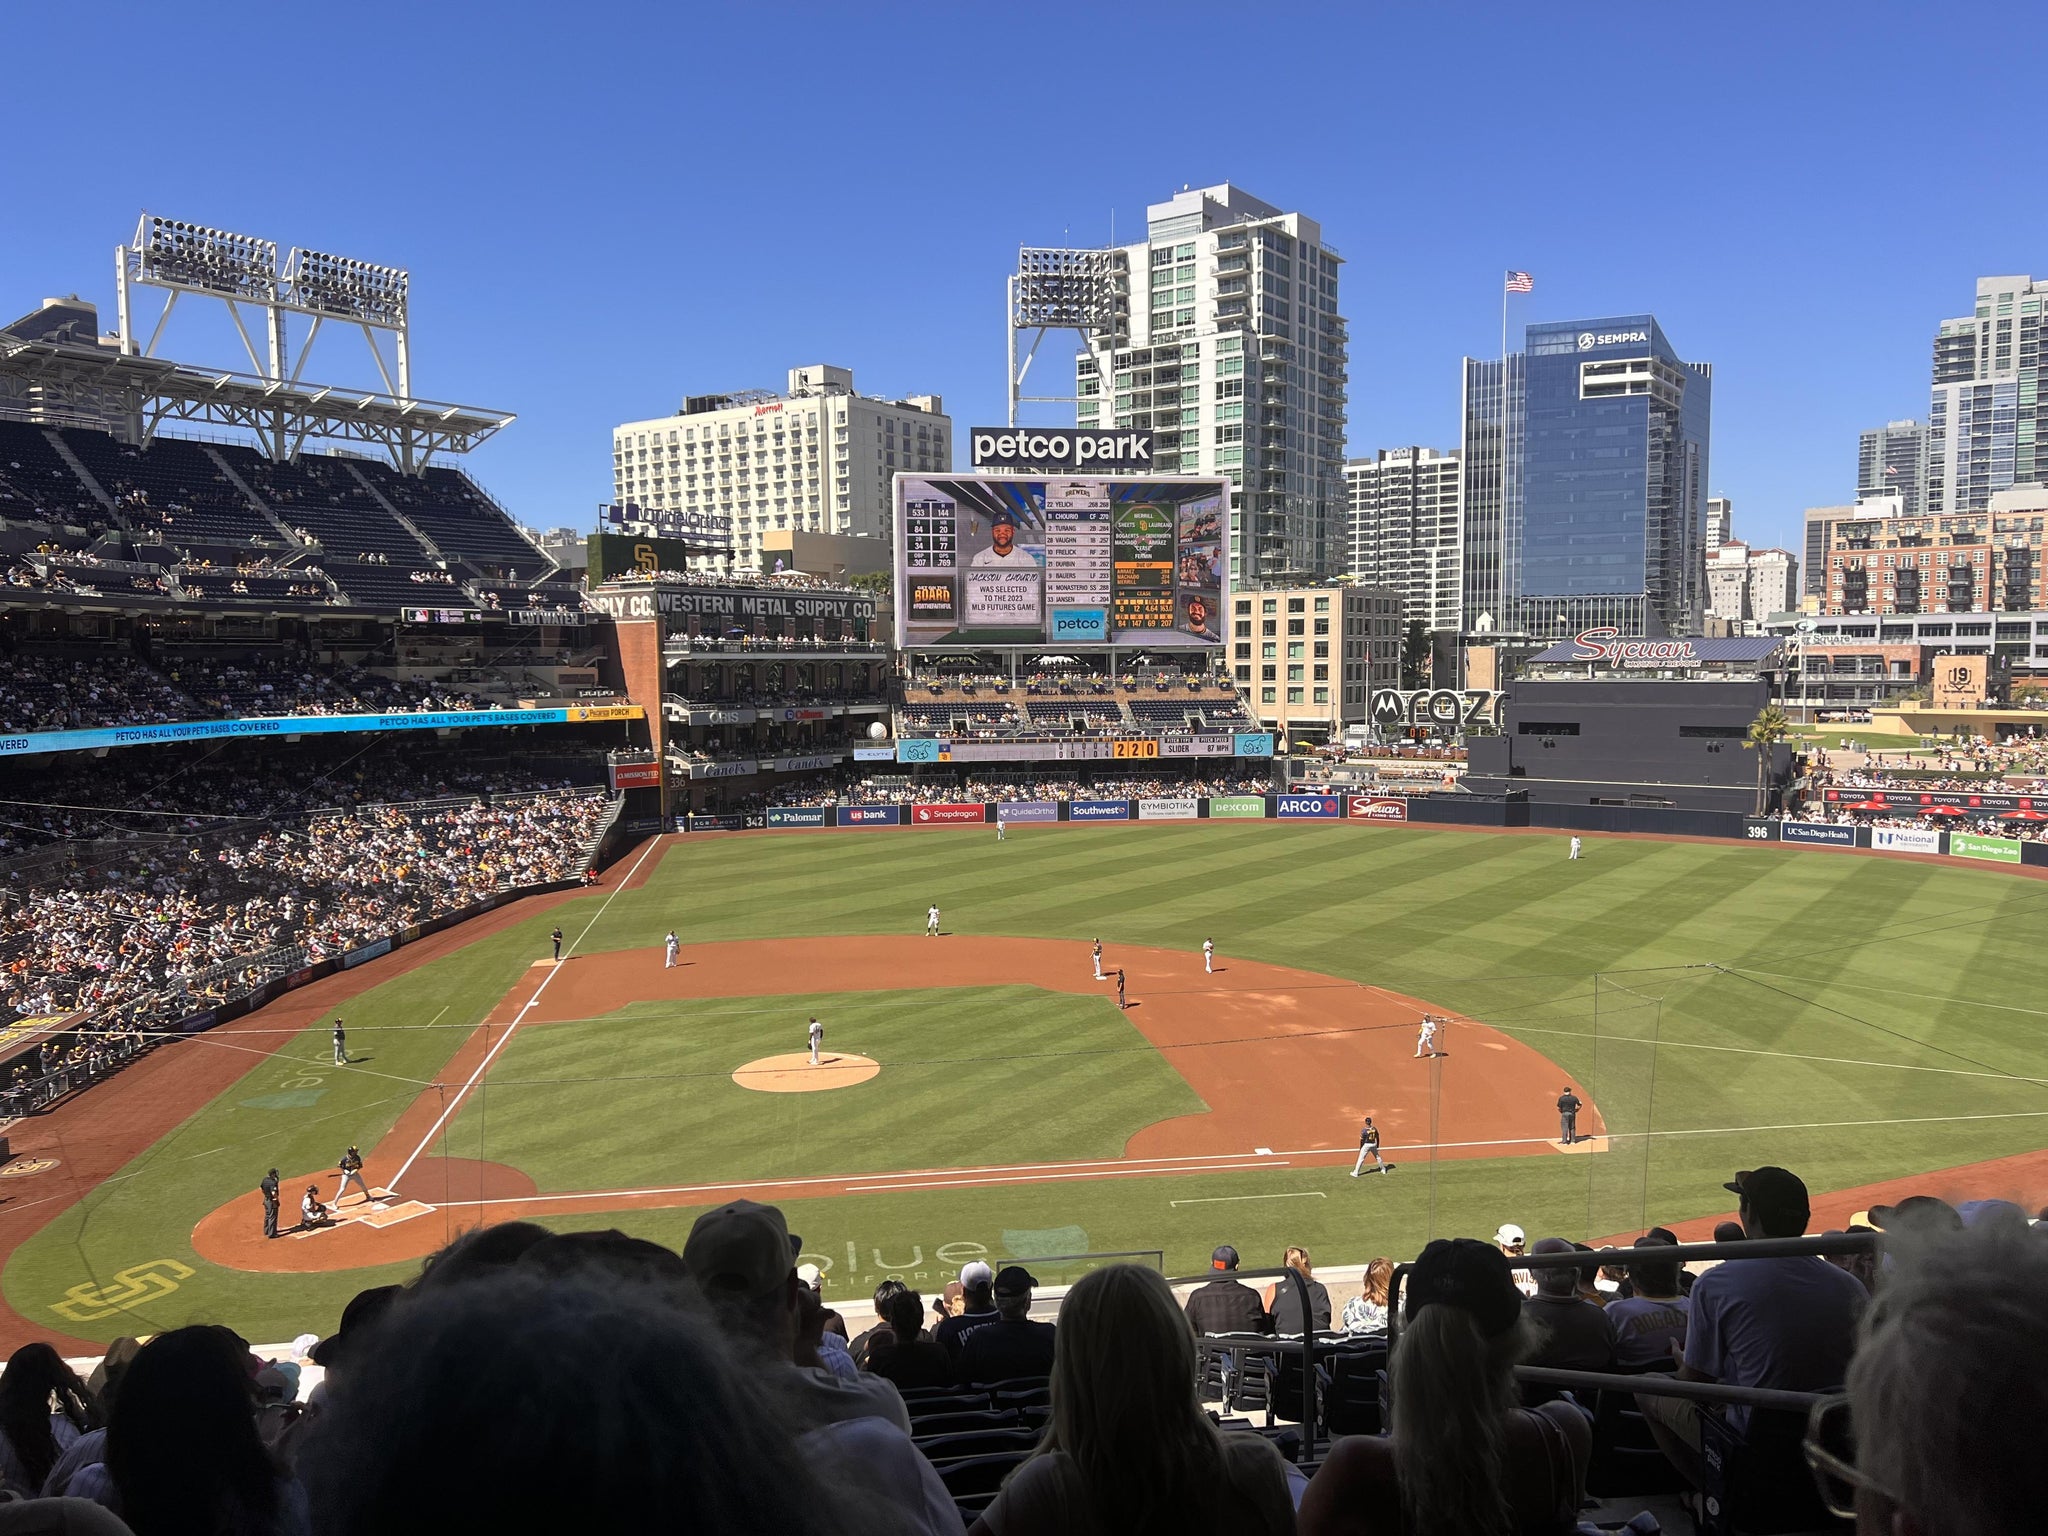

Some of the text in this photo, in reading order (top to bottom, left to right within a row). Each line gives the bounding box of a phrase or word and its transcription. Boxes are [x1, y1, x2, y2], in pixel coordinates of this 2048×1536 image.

[1597, 331, 1647, 345] SEMPRA
[754, 403, 783, 416] Marriott
[974, 430, 1149, 465] petco park
[968, 574, 1038, 582] JACKSON CHOURIO
[914, 588, 950, 602] BOARD
[630, 596, 655, 617] CO.
[657, 592, 876, 619] WESTERN METAL SUPPLY CO.
[1058, 618, 1099, 631] petco
[1814, 635, 1850, 645] Square
[1572, 627, 1696, 668] Sycuan
[1954, 668, 1967, 681] 19
[380, 717, 409, 726] PETCO
[411, 716, 429, 725] HAS
[448, 715, 470, 723] YOUR
[471, 714, 494, 722] PET'S
[520, 712, 556, 720] COVERED
[710, 712, 738, 723] ORIS
[116, 722, 279, 741] PETCO HAS ALL YOUR PET'S BASES COVERED
[1410, 728, 1426, 738] 0 13
[1118, 744, 1124, 756] 2
[1132, 744, 1138, 756] 2
[1147, 743, 1153, 755] 0
[670, 777, 685, 788] 336
[1073, 806, 1119, 815] Southwest
[1280, 801, 1321, 812] ARCO
[1352, 798, 1401, 817] Sycuan
[783, 813, 822, 822] Palomar
[864, 810, 886, 818] bank
[934, 810, 978, 819] Snapdragon
[746, 817, 763, 826] 342
[1748, 826, 1768, 838] 396
[1787, 828, 1848, 839] UC San Diego Health
[1895, 834, 1934, 844] National
[1985, 844, 2002, 855] Diego
[2002, 847, 2018, 855] Zoo
